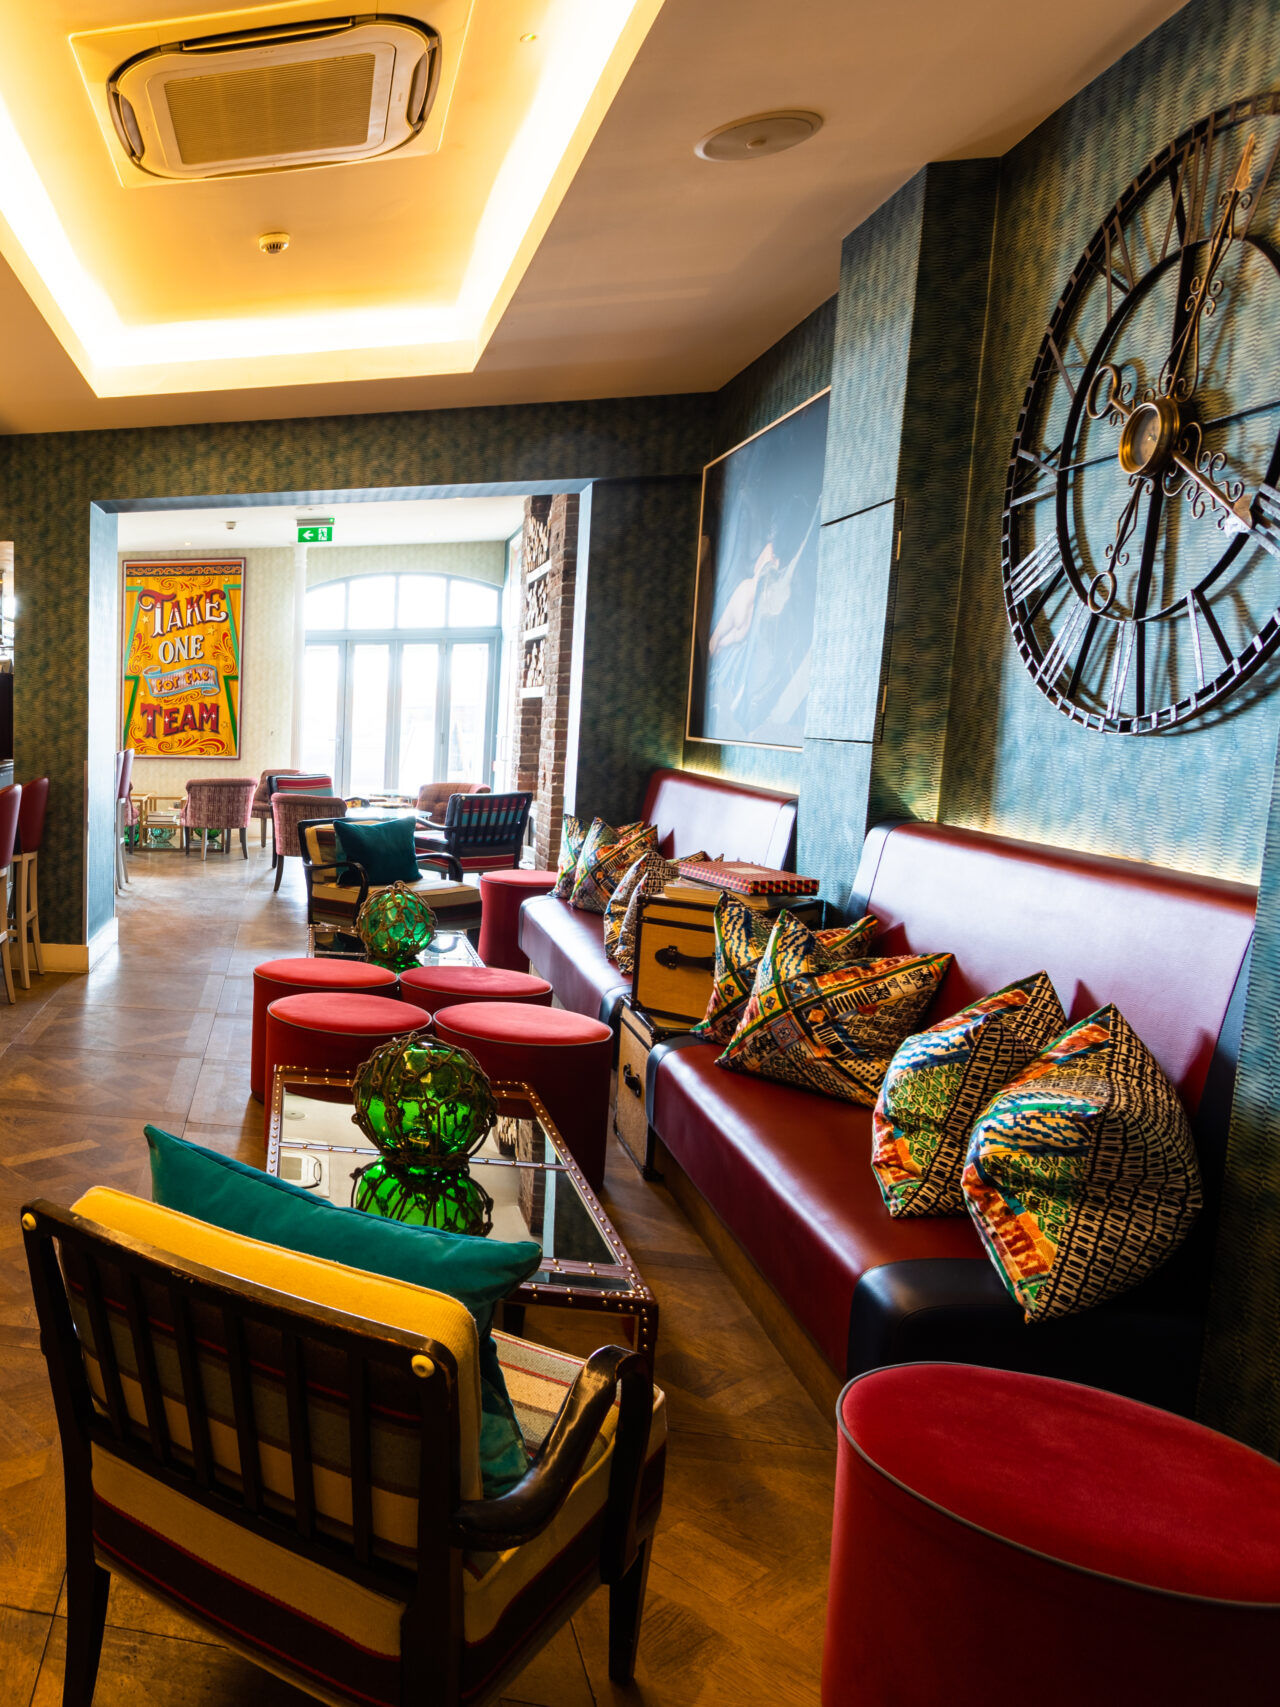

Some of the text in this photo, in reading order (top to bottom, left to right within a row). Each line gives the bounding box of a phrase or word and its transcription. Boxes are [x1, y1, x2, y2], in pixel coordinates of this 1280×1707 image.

[138, 588, 229, 638] TAKE
[158, 634, 205, 664] ONE
[156, 668, 210, 692] for the
[140, 702, 220, 739] TEAM
